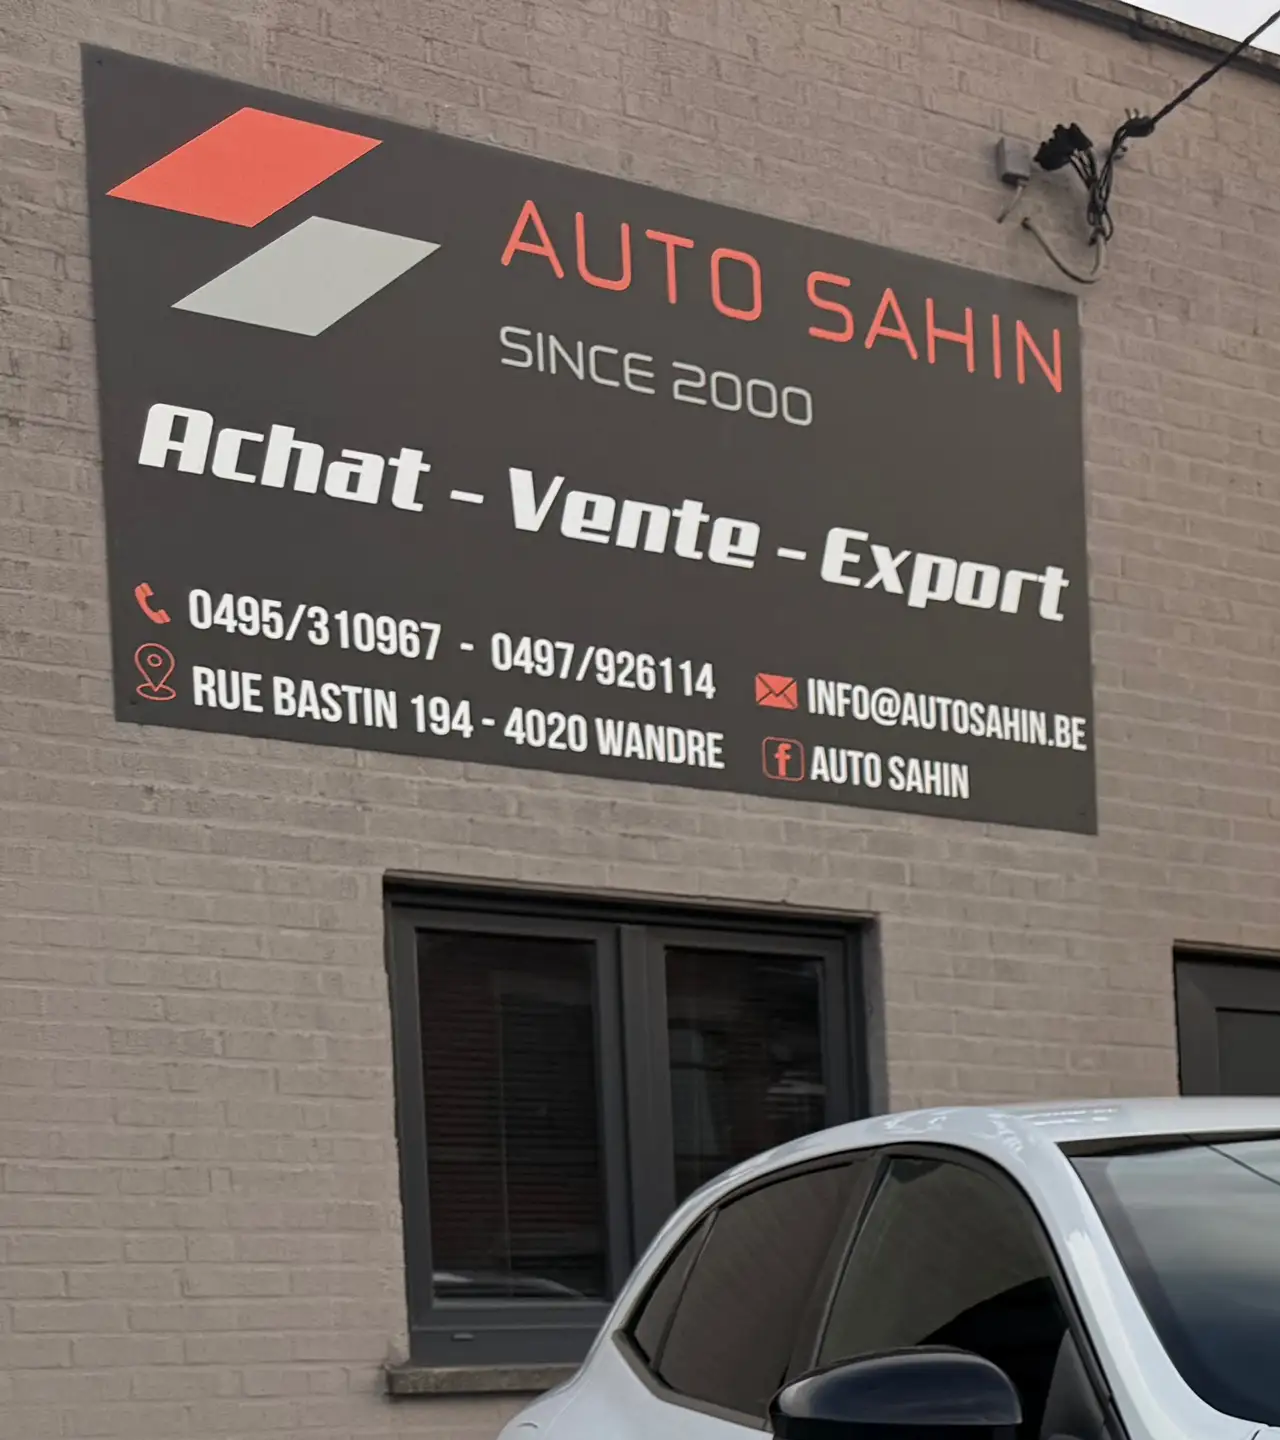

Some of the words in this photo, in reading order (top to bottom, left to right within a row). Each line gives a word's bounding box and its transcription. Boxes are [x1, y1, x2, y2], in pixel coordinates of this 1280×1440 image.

[501, 200, 763, 321] AUTO
[807, 271, 1063, 393] SAHIN
[499, 325, 656, 395] SINCE
[672, 361, 813, 426] 2000
[137, 402, 432, 512] Achat
[508, 467, 761, 569] Vente
[820, 527, 1070, 622] Export
[188, 588, 442, 661] 0495/310967
[491, 632, 716, 700] 0497/926114
[192, 665, 264, 713] RUE
[272, 675, 398, 730] BASTIN
[410, 694, 474, 739] 194
[503, 706, 588, 753] 4020
[594, 717, 725, 769] WANDRE
[807, 677, 1087, 751] INFO@AUTOSAHIN.BE
[810, 745, 882, 788] AUTO
[887, 755, 970, 799] SAHIN
